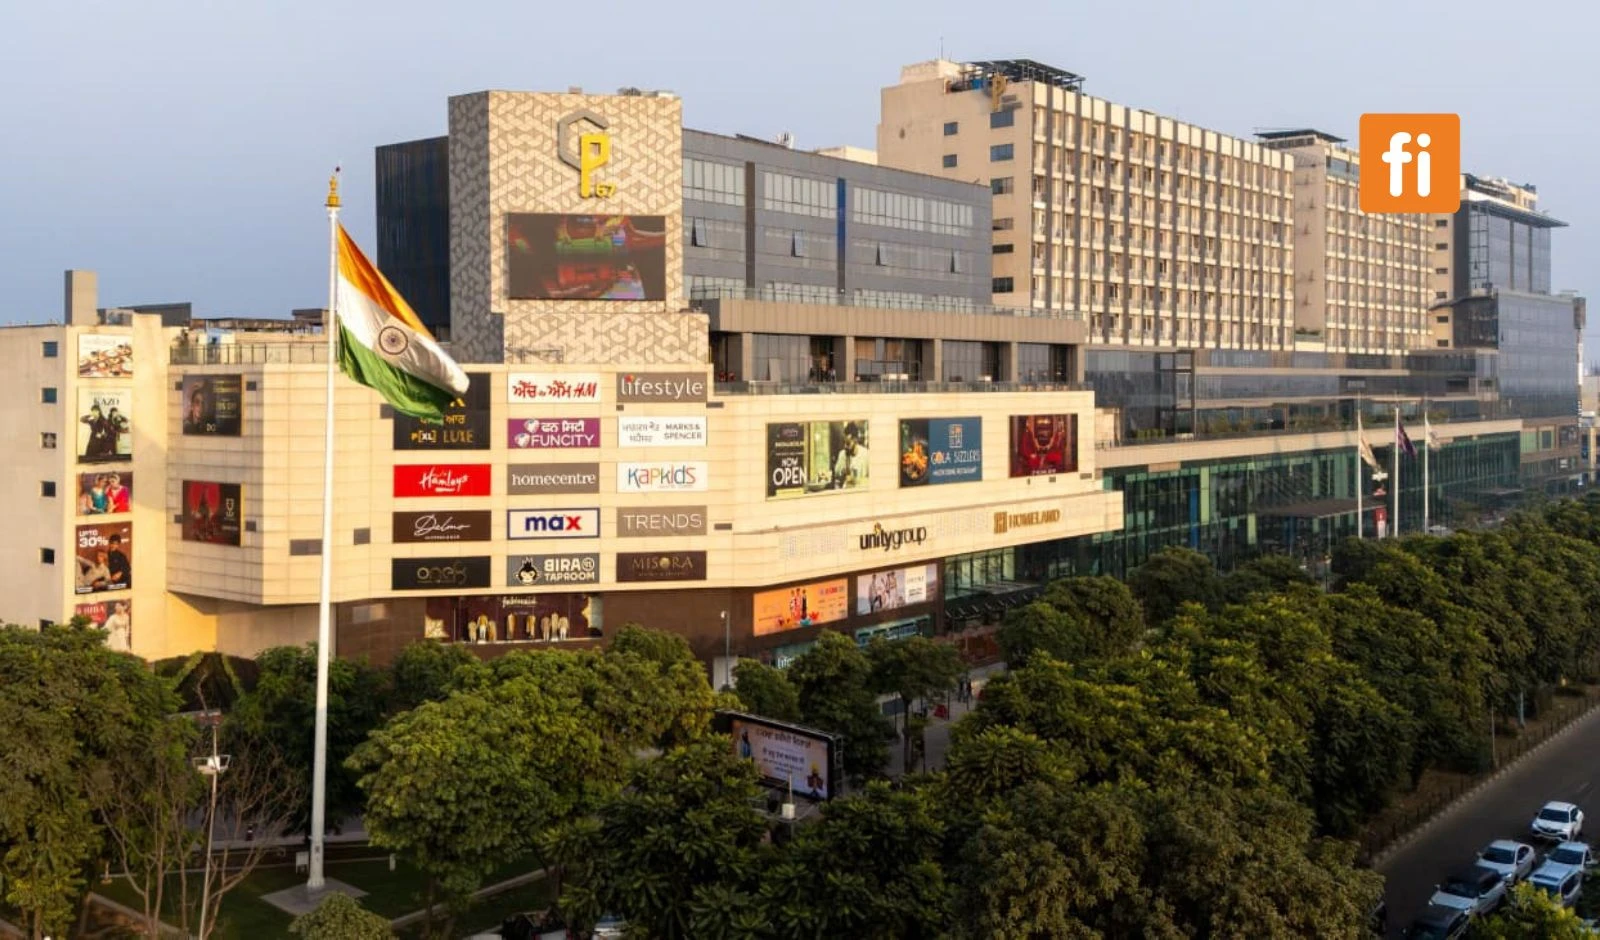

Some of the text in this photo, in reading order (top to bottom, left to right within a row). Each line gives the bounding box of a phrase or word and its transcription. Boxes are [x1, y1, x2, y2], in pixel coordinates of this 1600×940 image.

[621, 376, 704, 400] lifestyle
[531, 433, 595, 447] FUNCITY
[664, 431, 702, 440] SPENCER
[781, 457, 799, 468] NOW
[418, 466, 470, 492] Hamleys
[511, 473, 597, 487] homecentre
[772, 466, 808, 487] OPEN
[525, 516, 582, 531] max
[623, 513, 703, 529] TRENDS
[79, 535, 110, 548] 30%
[543, 571, 596, 582] TAPROOM
